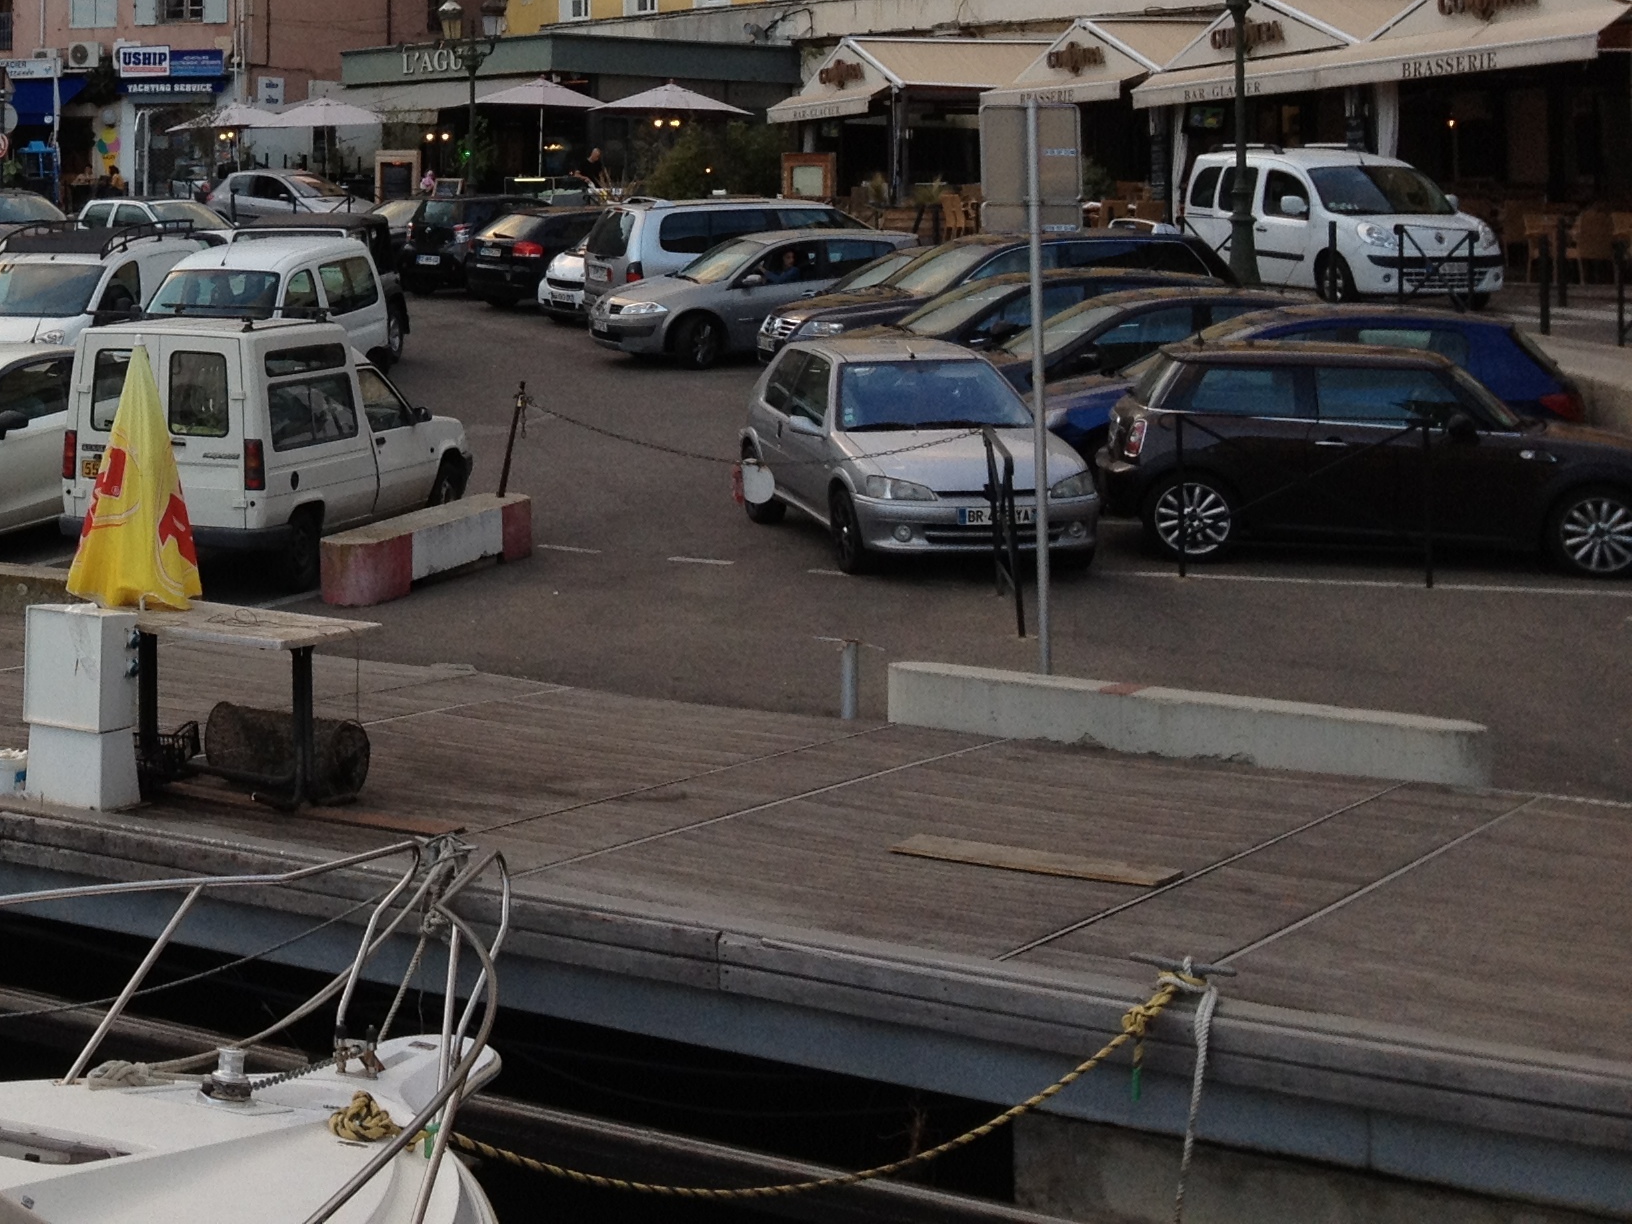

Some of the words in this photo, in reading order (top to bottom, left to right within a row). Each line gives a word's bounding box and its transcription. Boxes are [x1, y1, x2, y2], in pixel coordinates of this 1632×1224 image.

[123, 52, 167, 66] USHIP
[402, 47, 464, 74] L'AGU
[1402, 52, 1498, 78] BRASSERIE
[127, 84, 171, 92] YACHTING
[174, 83, 212, 92] SERVICE
[1184, 88, 1205, 100] BAR
[1212, 81, 1261, 96] GLAER
